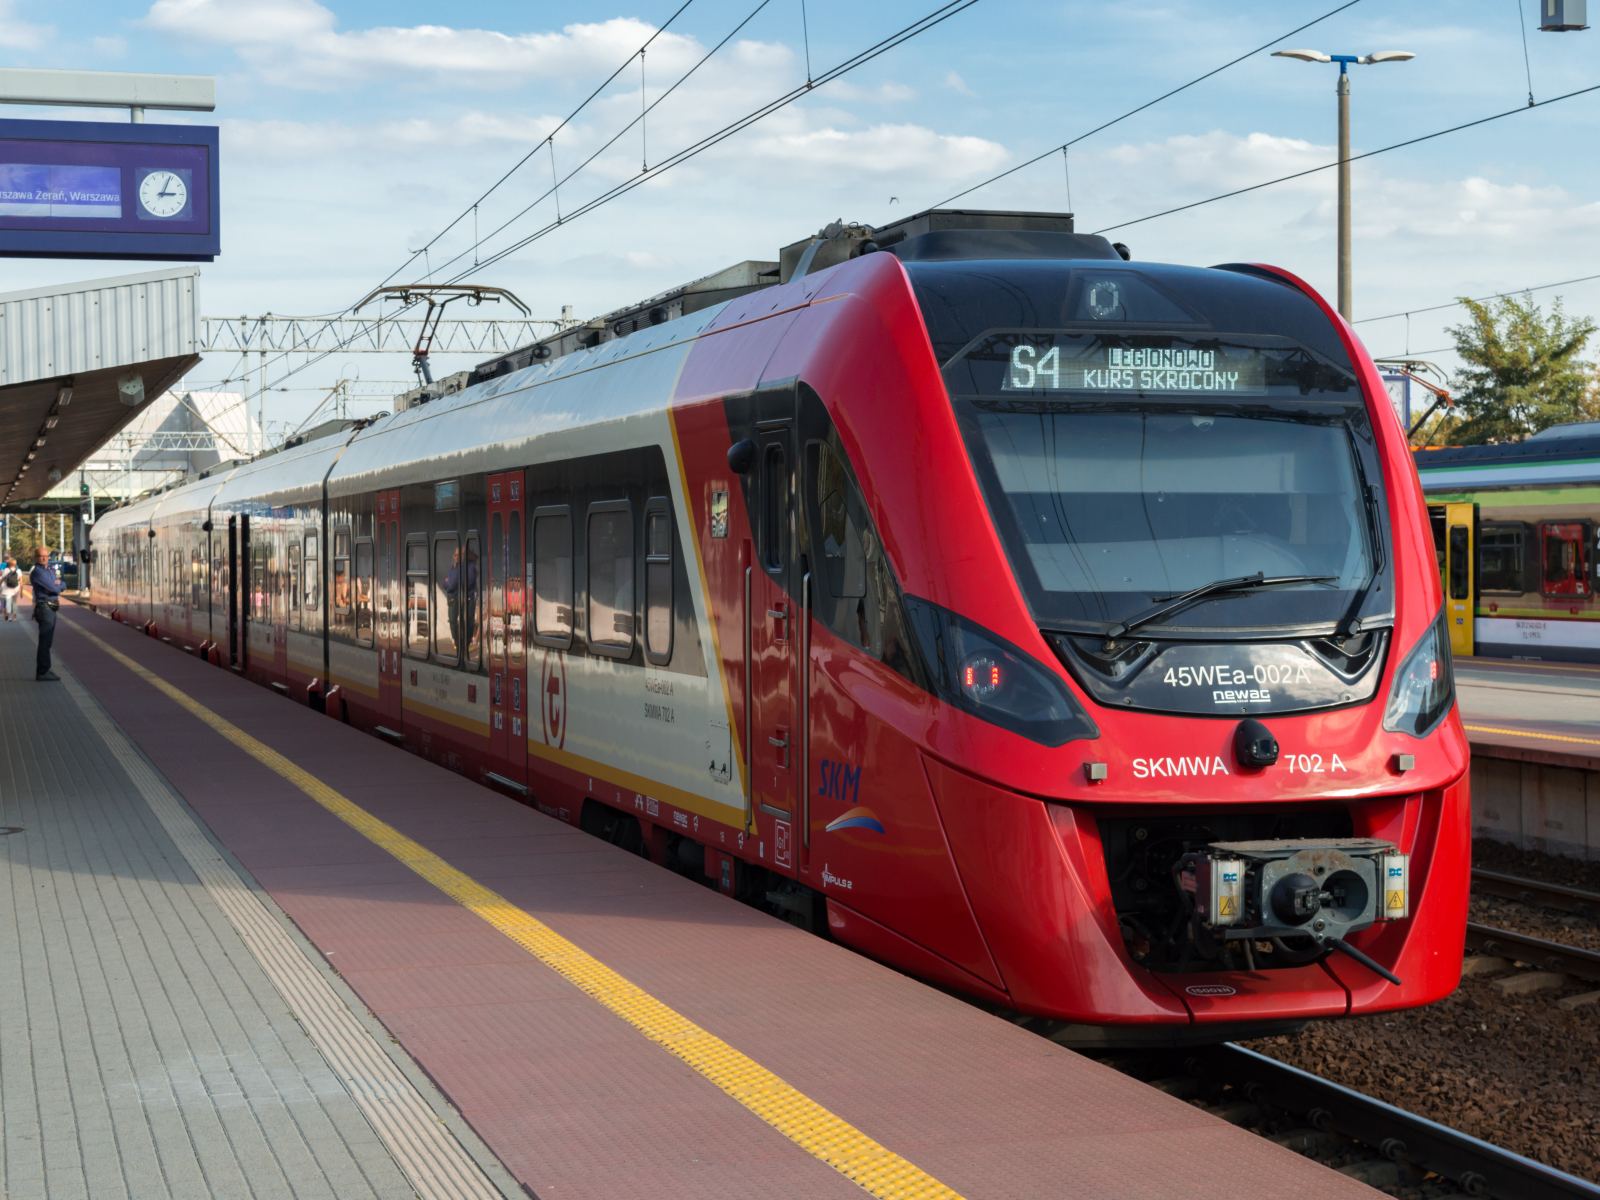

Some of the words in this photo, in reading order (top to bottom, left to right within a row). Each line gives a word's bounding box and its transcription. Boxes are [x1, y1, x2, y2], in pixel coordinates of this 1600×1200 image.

[69, 191, 120, 202] Warszawa
[1012, 345, 1060, 389] S4
[1109, 348, 1214, 370] LEGIONOWO
[1083, 369, 1134, 388] KURS
[1132, 756, 1229, 778] SKMWA
[1283, 754, 1325, 774] 702
[1331, 754, 1347, 773] A
[818, 759, 862, 803] SKM
